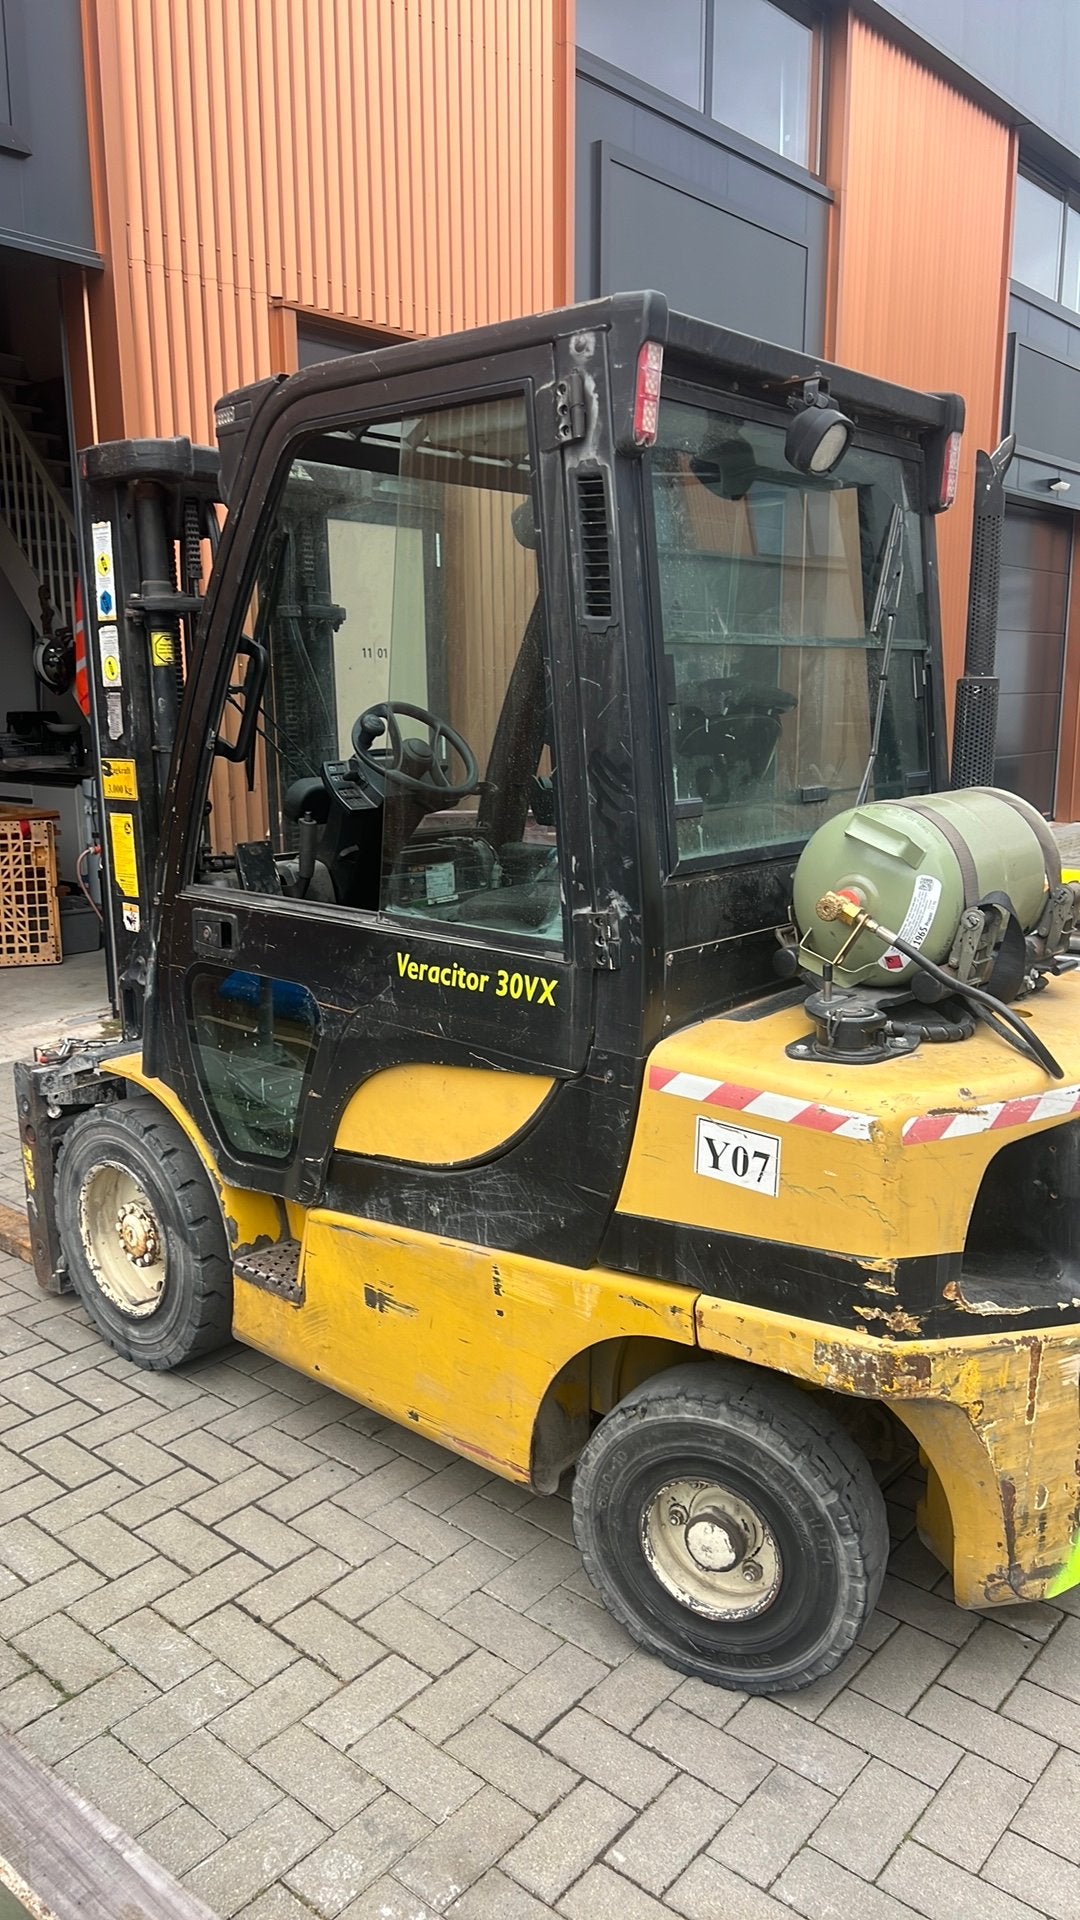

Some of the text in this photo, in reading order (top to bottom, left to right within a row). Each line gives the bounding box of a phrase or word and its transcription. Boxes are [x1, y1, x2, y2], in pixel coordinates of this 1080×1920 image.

[362, 647, 388, 659] 11 01
[914, 927, 928, 945] 1965
[396, 951, 559, 1008] Veracitor 30VX
[703, 1136, 771, 1183] Y07
